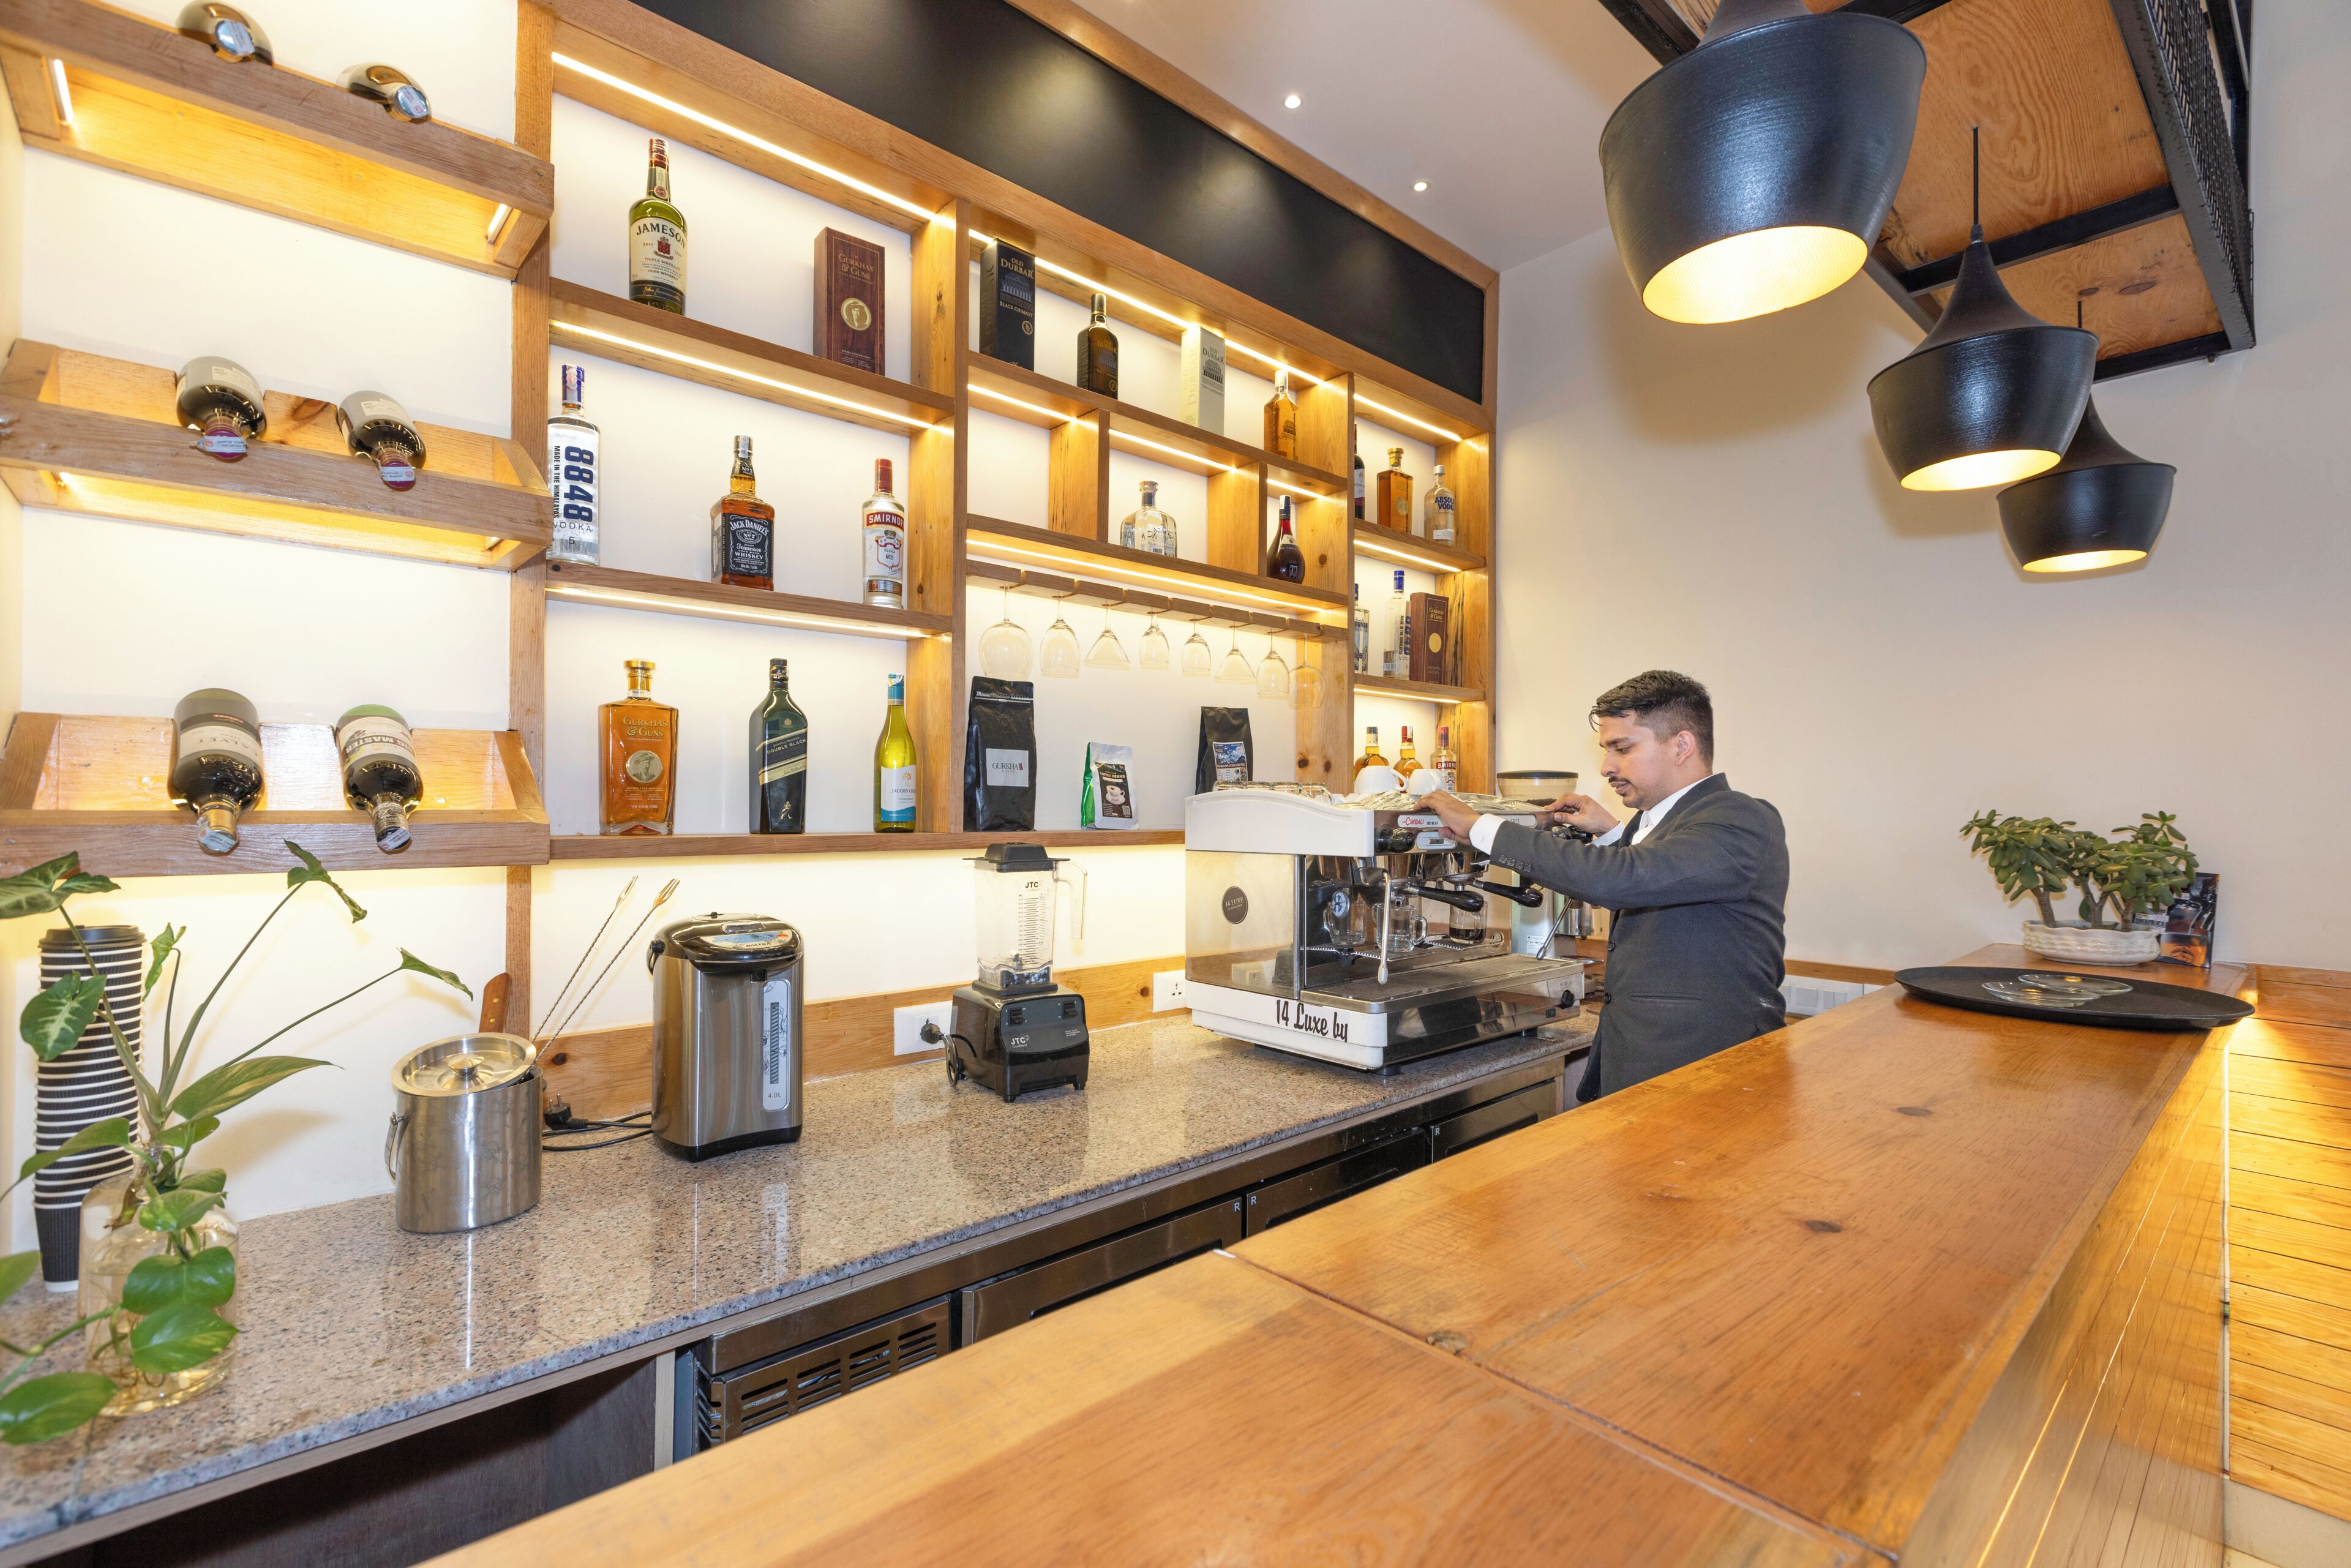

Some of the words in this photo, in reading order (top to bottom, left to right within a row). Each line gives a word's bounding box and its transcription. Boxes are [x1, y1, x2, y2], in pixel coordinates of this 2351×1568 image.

[637, 223, 686, 249] JAMESON
[842, 263, 849, 272] &
[1000, 258, 1033, 279] DURBAR
[1011, 258, 1024, 267] OLD
[1000, 301, 1014, 310] BLACK
[1014, 307, 1033, 318] CHIMNEY
[1202, 348, 1224, 364] DURBAR
[563, 446, 594, 522] 8848
[869, 514, 904, 527] SMIRNOF
[553, 521, 593, 533] VODKA
[730, 520, 744, 531] JACK
[745, 519, 769, 536] DANIEL'S
[737, 543, 762, 552] Tennessee
[735, 551, 763, 560] WHISKEY
[627, 726, 637, 736] &
[639, 727, 664, 737] GUNS
[345, 737, 394, 753] MASTER
[767, 745, 788, 754] DOUBLE
[789, 738, 806, 747] BLACK
[1406, 817, 1425, 826] CIMBALI
[1276, 999, 1289, 1027] 14
[1294, 1002, 1329, 1037] Luxe
[1333, 1011, 1348, 1043] by
[1436, 1127, 1440, 1136] R
[1234, 1202, 1240, 1212] R
[1251, 1196, 1257, 1206] R
